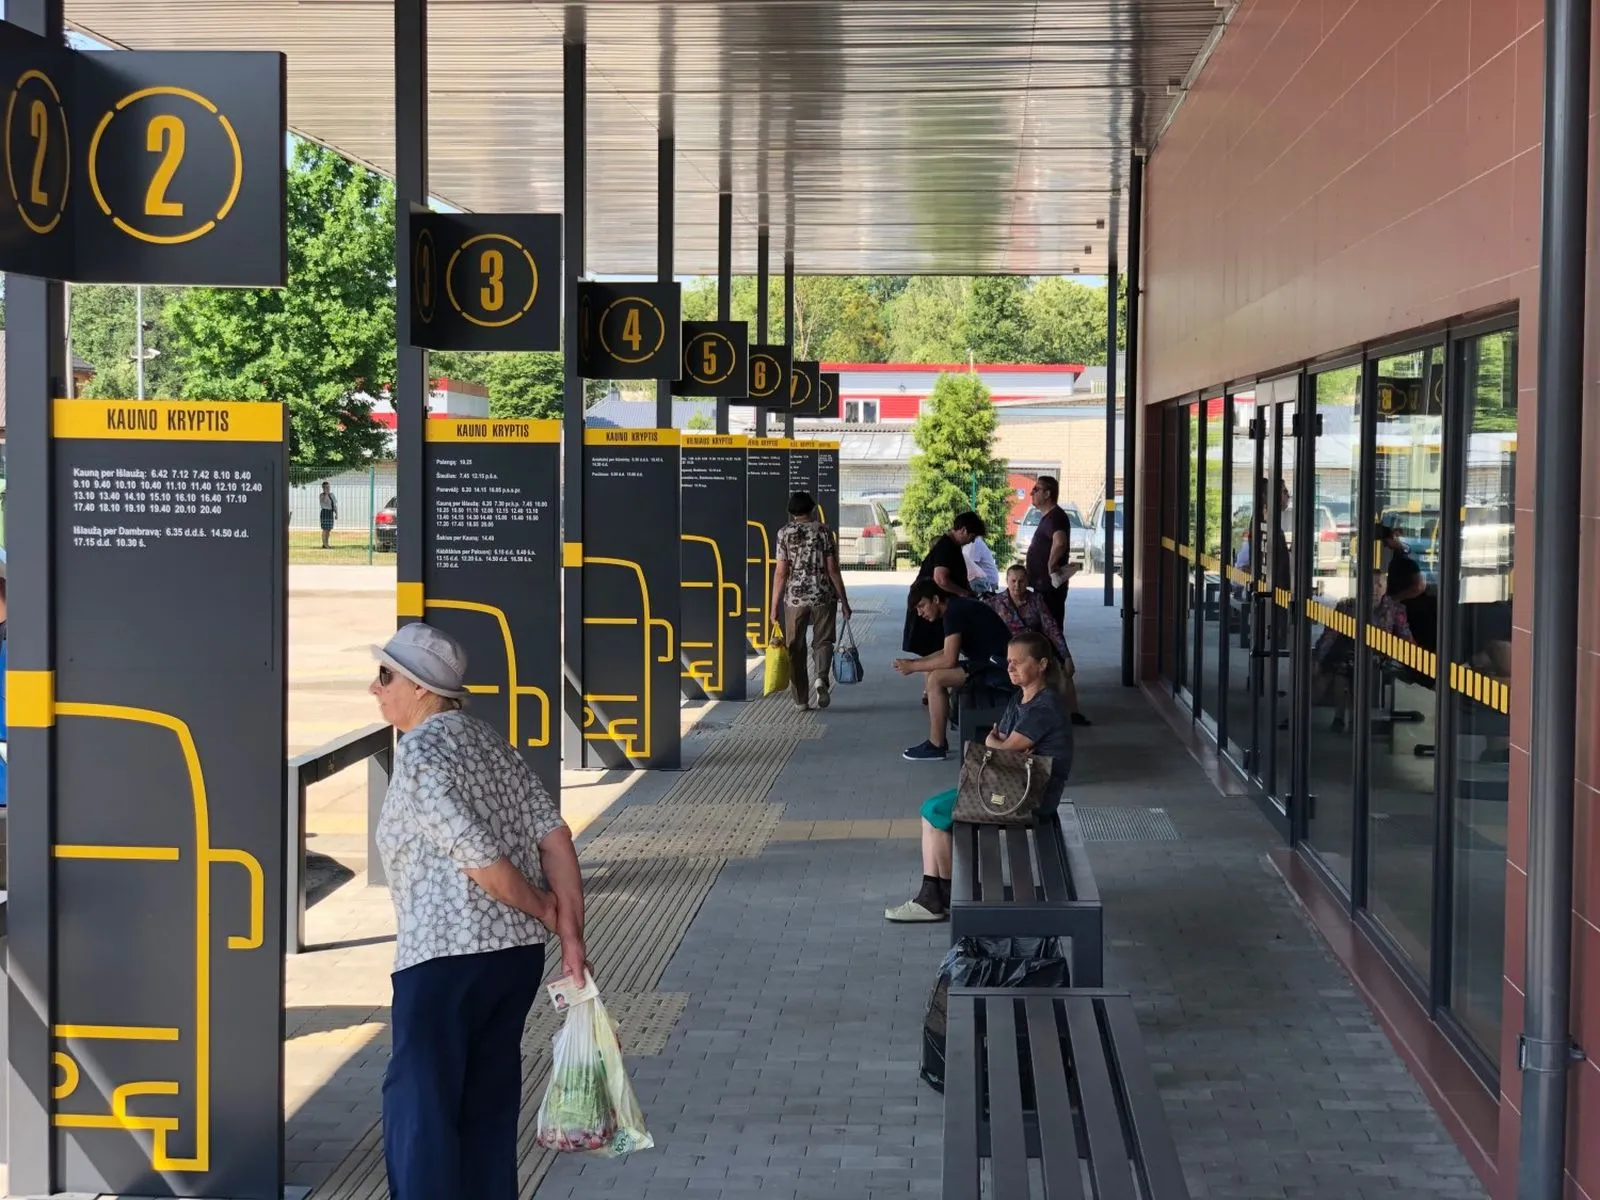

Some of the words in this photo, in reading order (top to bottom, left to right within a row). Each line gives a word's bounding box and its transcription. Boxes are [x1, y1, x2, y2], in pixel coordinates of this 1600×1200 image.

[31, 99, 49, 207] 2
[145, 114, 185, 217] 2
[480, 249, 504, 311] 3
[622, 308, 642, 351] 4
[703, 341, 717, 375] 5
[754, 361, 766, 390] 6
[790, 375, 799, 399] 7
[107, 408, 157, 431] KAUNO
[168, 409, 229, 432] KRYPTIS
[457, 424, 487, 437] KAUNO
[492, 424, 529, 438] KRYPTIS
[606, 432, 628, 442] KAUNO
[631, 432, 658, 442] KRYPTIS
[73, 468, 100, 479] Kauną
[101, 470, 115, 479] per
[151, 469, 168, 478] 6.42
[172, 469, 189, 479] 7.12
[193, 470, 210, 479] 7.42
[213, 470, 230, 479] 8.10
[234, 471, 251, 480] 8.40
[73, 480, 90, 488] 9.10
[94, 480, 111, 489] 9.40
[115, 480, 136, 489] 10.10
[140, 481, 162, 490] 10.40
[166, 481, 187, 490] 11.10
[191, 482, 212, 491] 11.40
[216, 482, 237, 491] 12.10
[241, 483, 262, 492] 12.40
[74, 491, 95, 500] 13.10
[99, 491, 120, 501] 13.40
[124, 492, 146, 501] 14.10
[150, 492, 171, 501] 15.10
[175, 493, 196, 502] 16.10
[200, 493, 221, 503] 16.40
[226, 494, 247, 503] 17.10
[74, 502, 95, 512] 17.40
[99, 503, 120, 512] 18.10
[124, 503, 146, 512] 19.10
[150, 504, 171, 513] 19.40
[174, 504, 196, 513] 20.10
[200, 505, 221, 514] 20.40
[74, 537, 95, 547] 17.15
[96, 538, 112, 547] d.d.
[116, 538, 137, 547] 10.30
[103, 528, 117, 537] per
[118, 527, 162, 538] Dambravą:
[166, 527, 183, 536] 6.35
[211, 528, 232, 537] 14.50
[233, 529, 249, 538] d.d.
